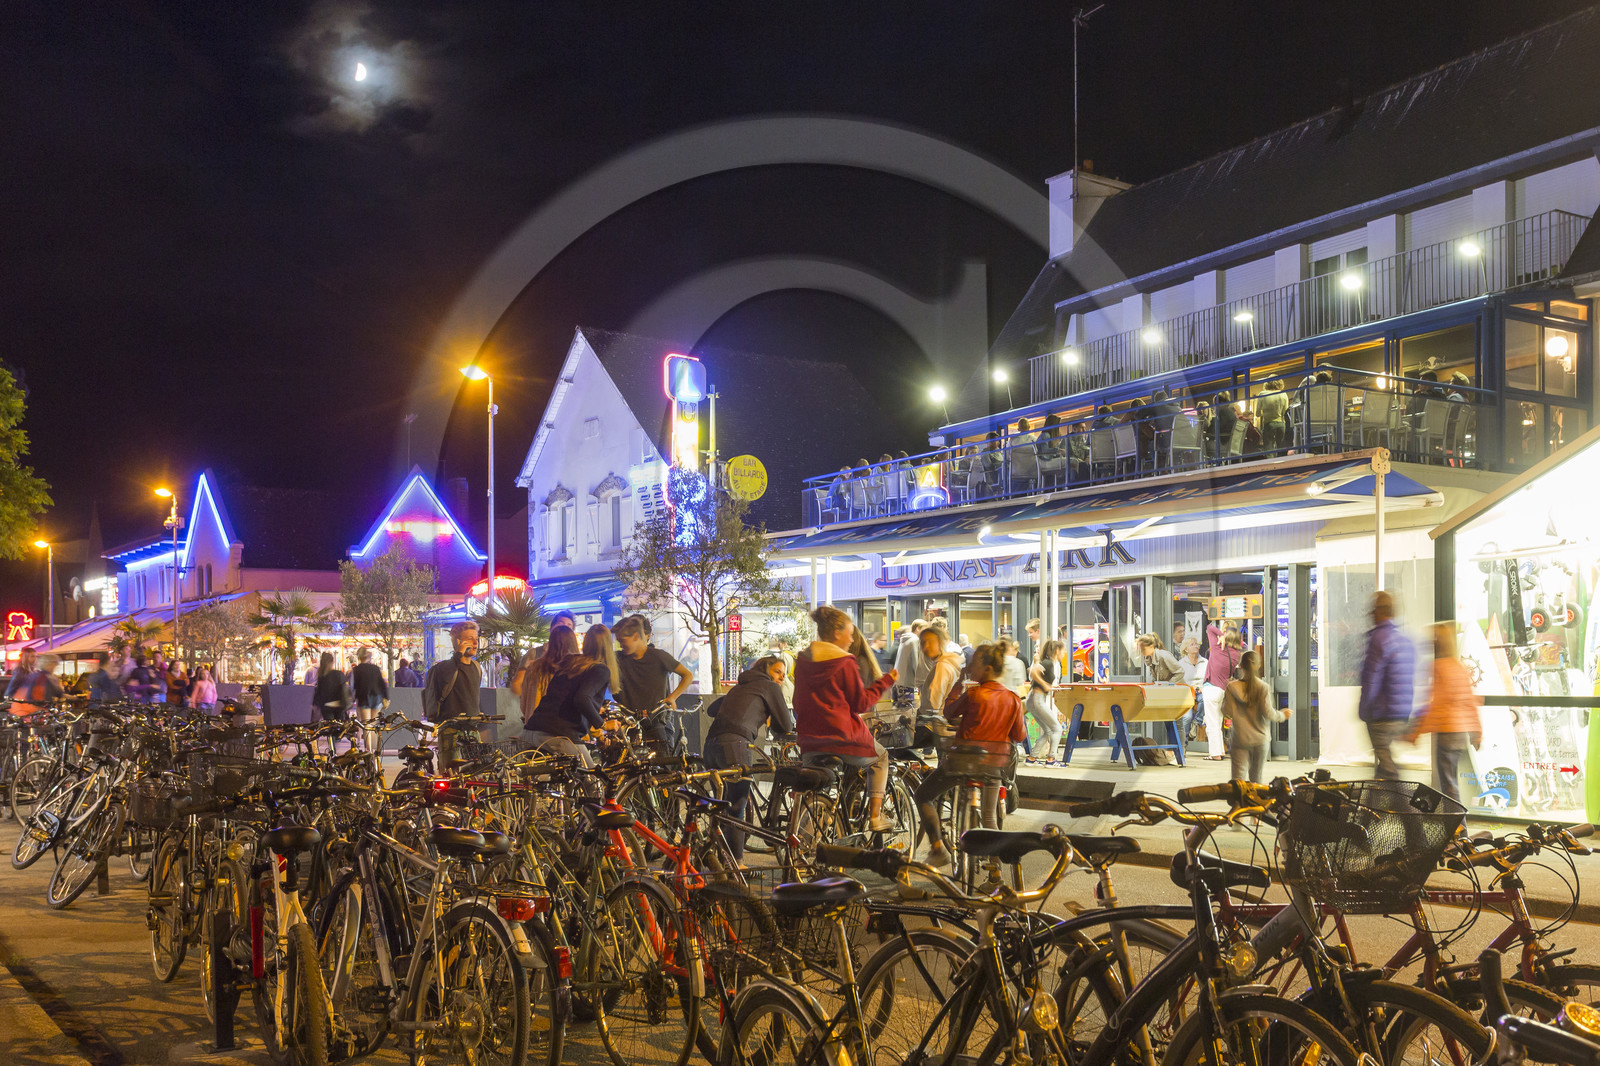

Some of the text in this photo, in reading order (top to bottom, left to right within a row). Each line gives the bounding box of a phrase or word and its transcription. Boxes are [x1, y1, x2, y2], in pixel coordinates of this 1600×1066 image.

[742, 457, 757, 467] BAR
[733, 467, 765, 480] BILLARDS
[733, 479, 741, 490] AU
[749, 481, 766, 499] ETAGE
[1523, 761, 1557, 771] ENTREE
